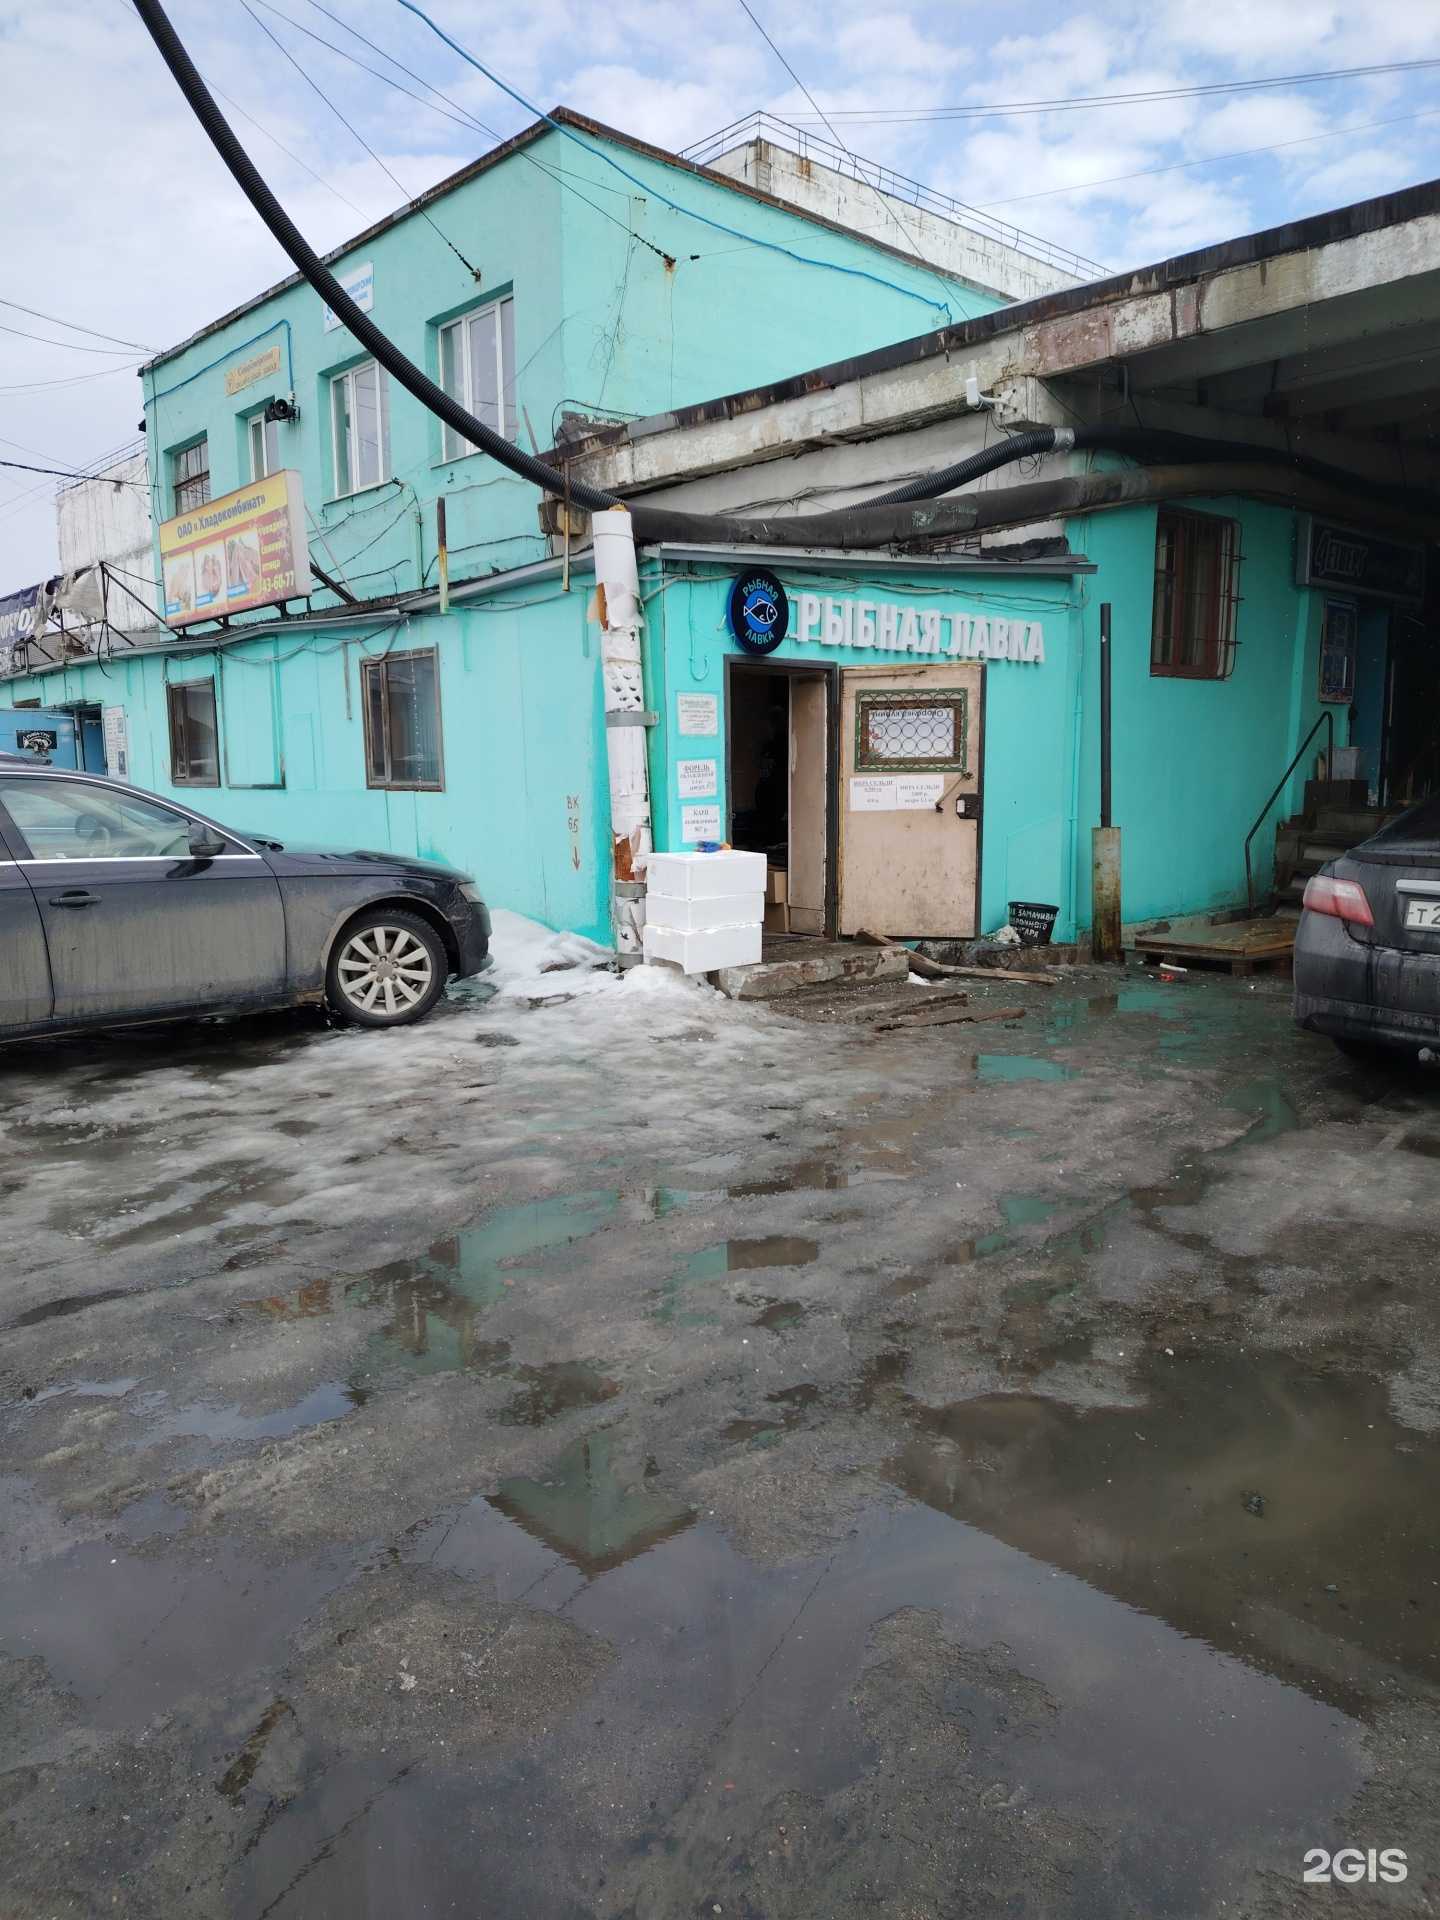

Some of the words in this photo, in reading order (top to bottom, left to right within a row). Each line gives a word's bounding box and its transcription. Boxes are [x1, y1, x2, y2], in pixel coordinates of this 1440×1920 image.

[177, 522, 193, 538] ОАО
[742, 579, 779, 601] РЫБНАЯ
[745, 629, 775, 645] ЛАВКА
[797, 593, 941, 653] РЫБНАЯ
[946, 612, 1045, 663] ЛАВКА
